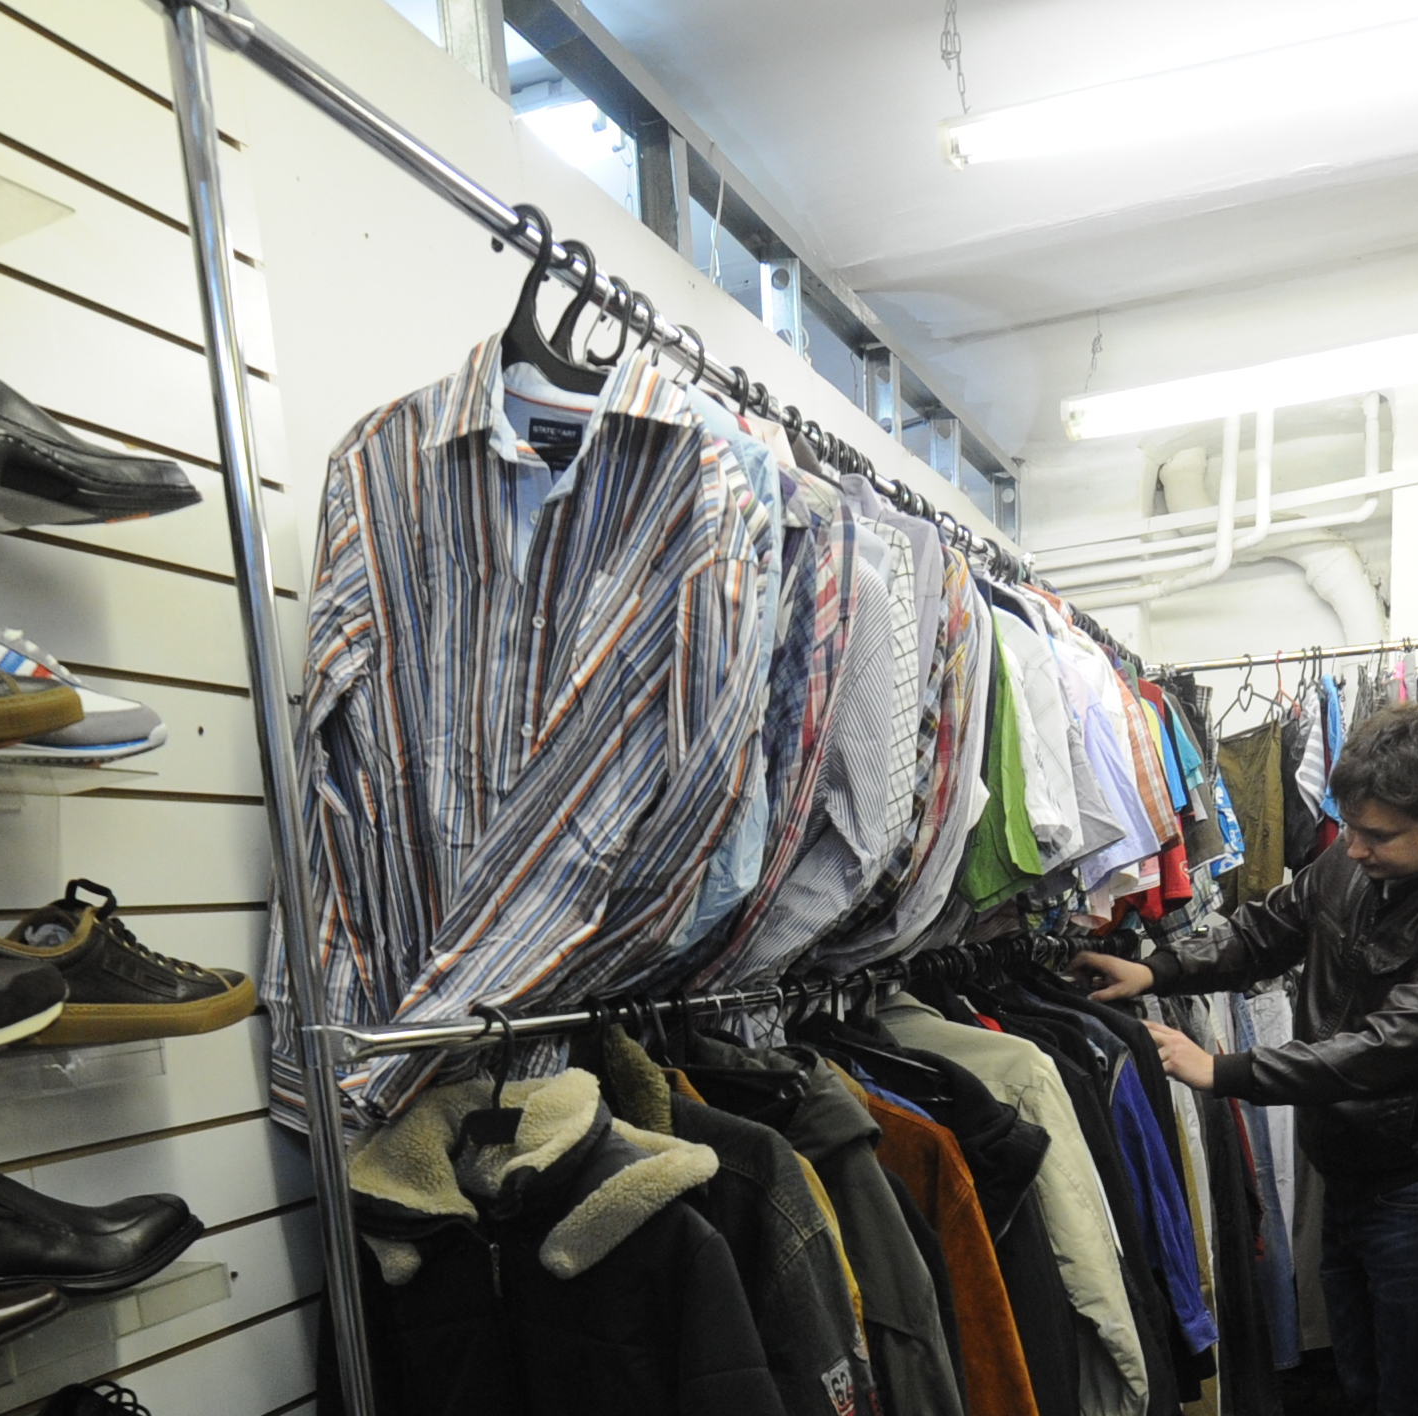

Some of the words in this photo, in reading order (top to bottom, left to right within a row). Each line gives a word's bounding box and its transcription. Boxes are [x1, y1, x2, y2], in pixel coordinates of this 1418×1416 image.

[532, 425, 556, 435] STATE
[561, 429, 577, 437] ART
[831, 1371, 854, 1406] 62
